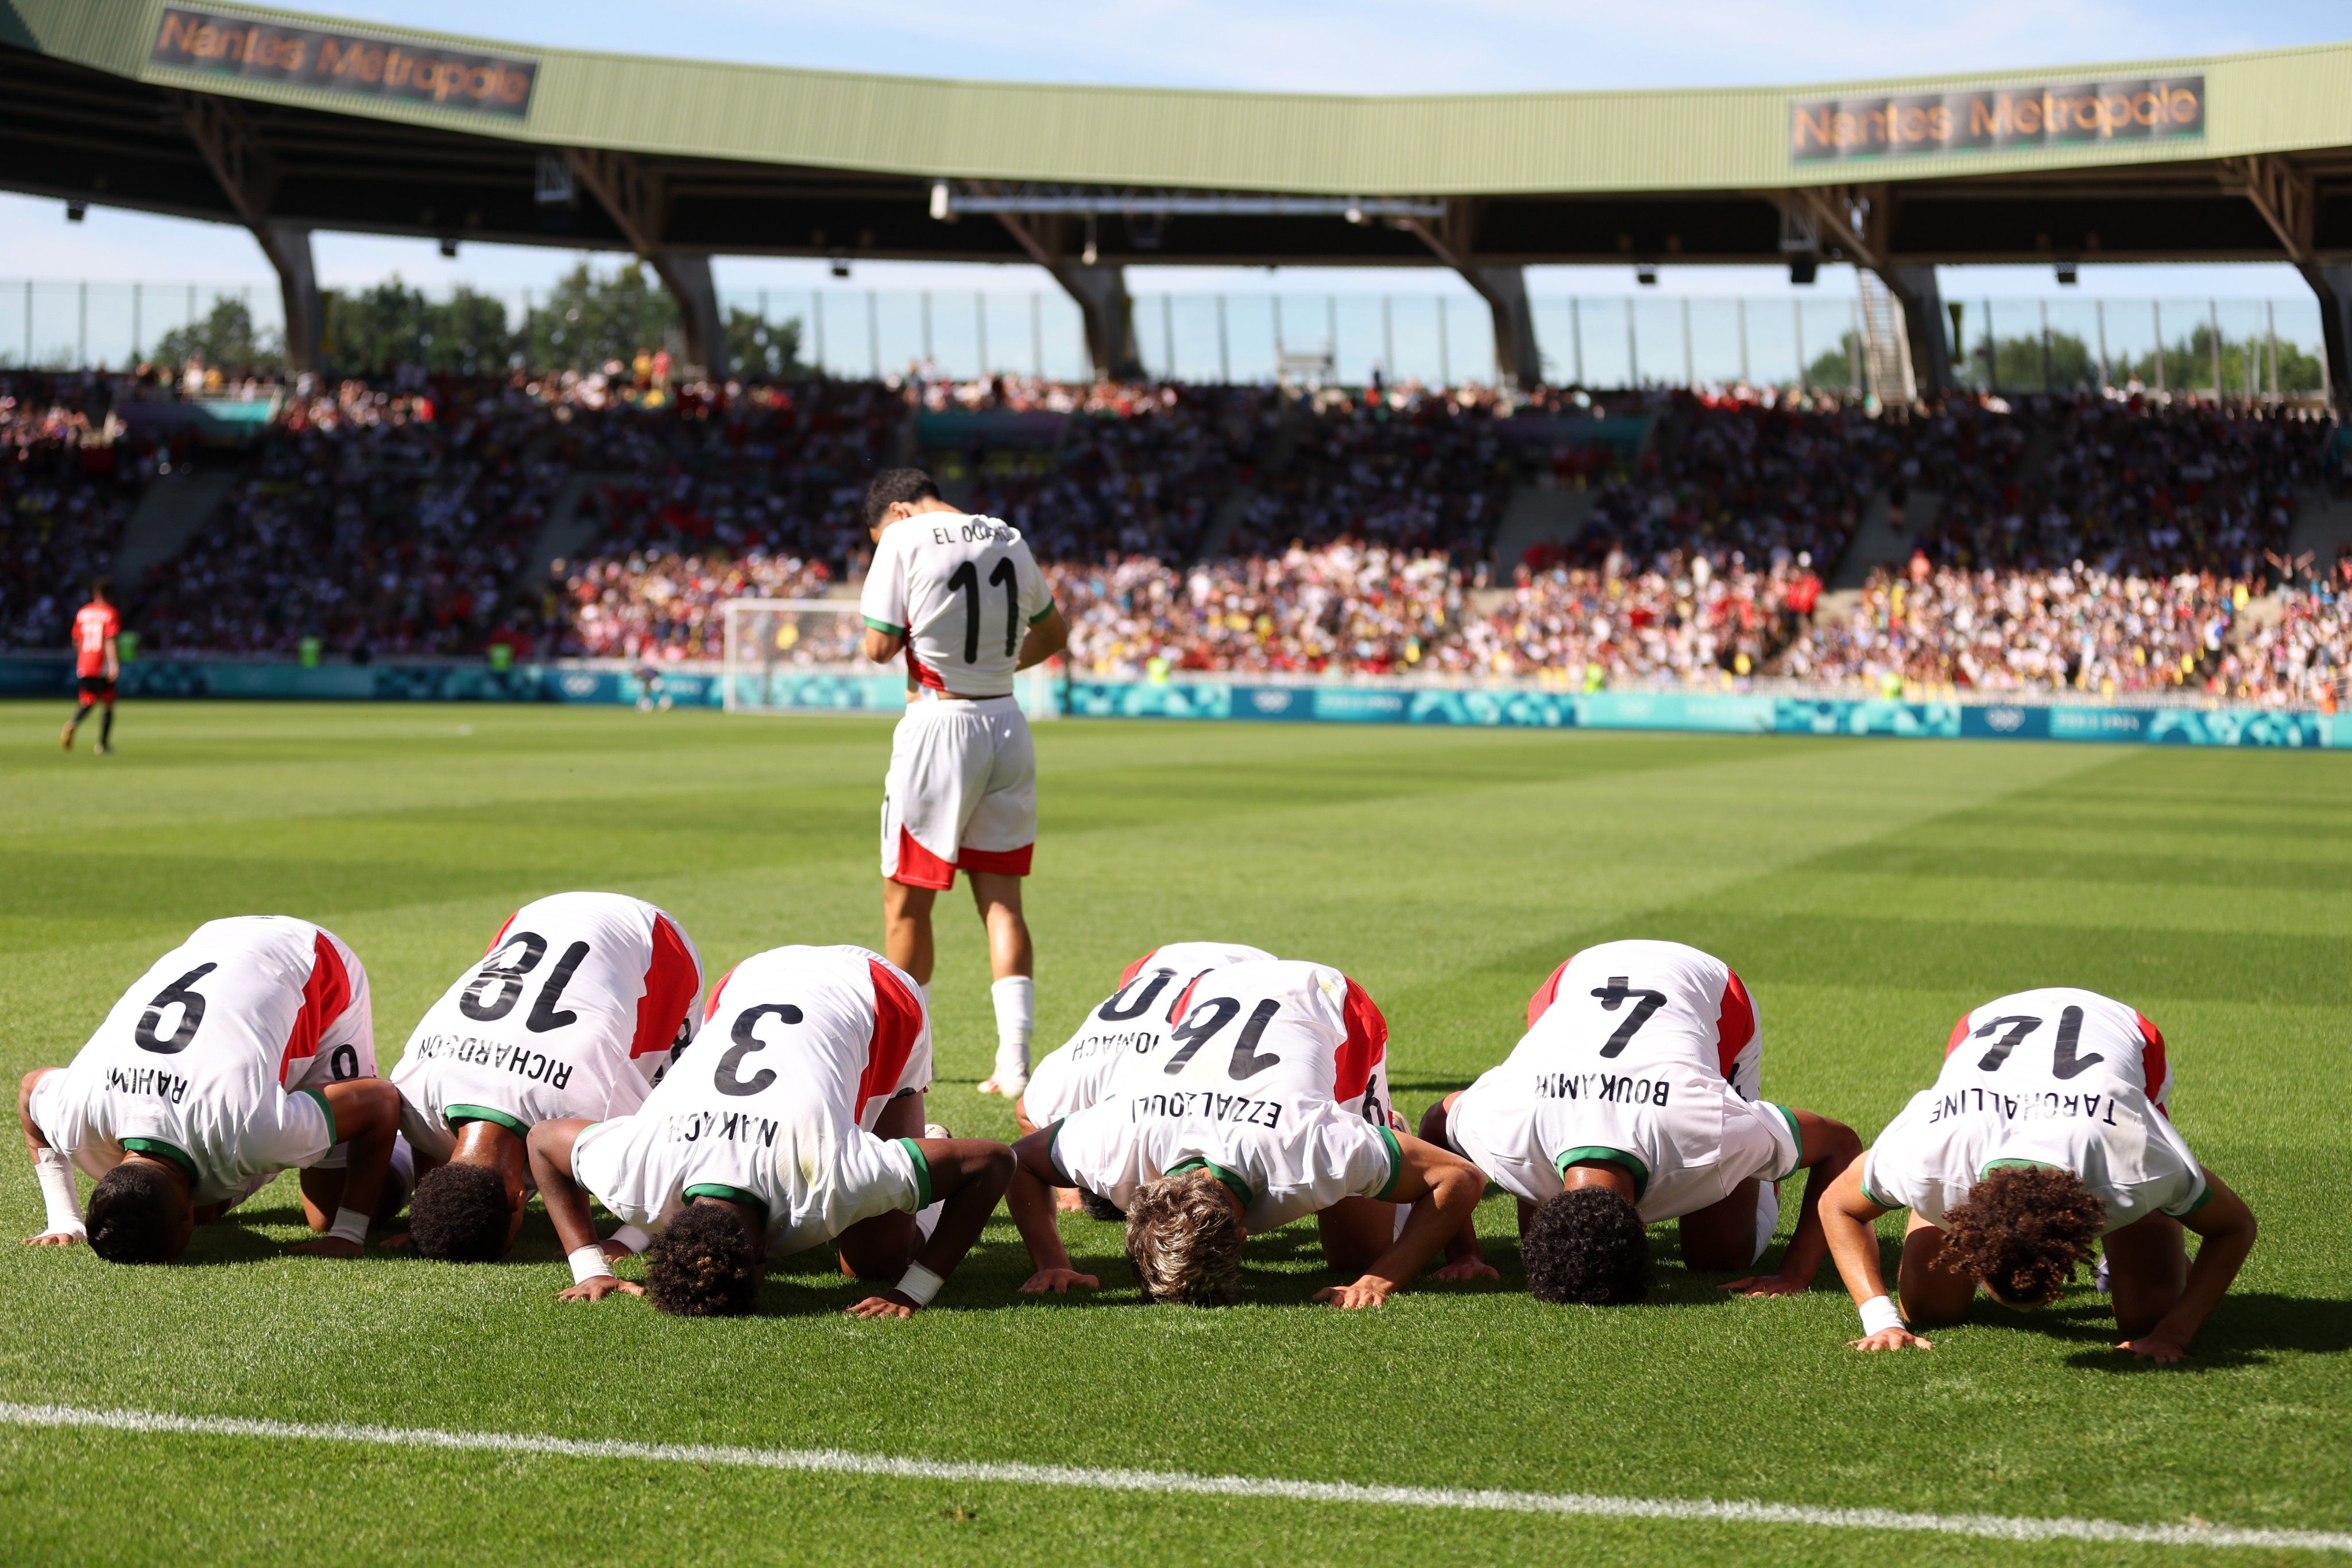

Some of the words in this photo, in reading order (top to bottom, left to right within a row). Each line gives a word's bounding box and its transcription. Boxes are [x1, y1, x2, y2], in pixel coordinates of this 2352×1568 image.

[158, 13, 307, 71] Nantes
[1793, 101, 1952, 148] Nantes
[933, 527, 956, 544] EL
[947, 556, 1019, 664] 11
[459, 931, 590, 1033] 18
[1163, 996, 1281, 1081] 16
[1590, 975, 1668, 1059] 4
[416, 1033, 573, 1090] RICHARDSON
[714, 1003, 804, 1097] 3
[105, 1066, 188, 1105] RAHIMI
[1534, 1073, 1670, 1107] BOUKAMIR
[667, 1110, 779, 1148] NAKACH
